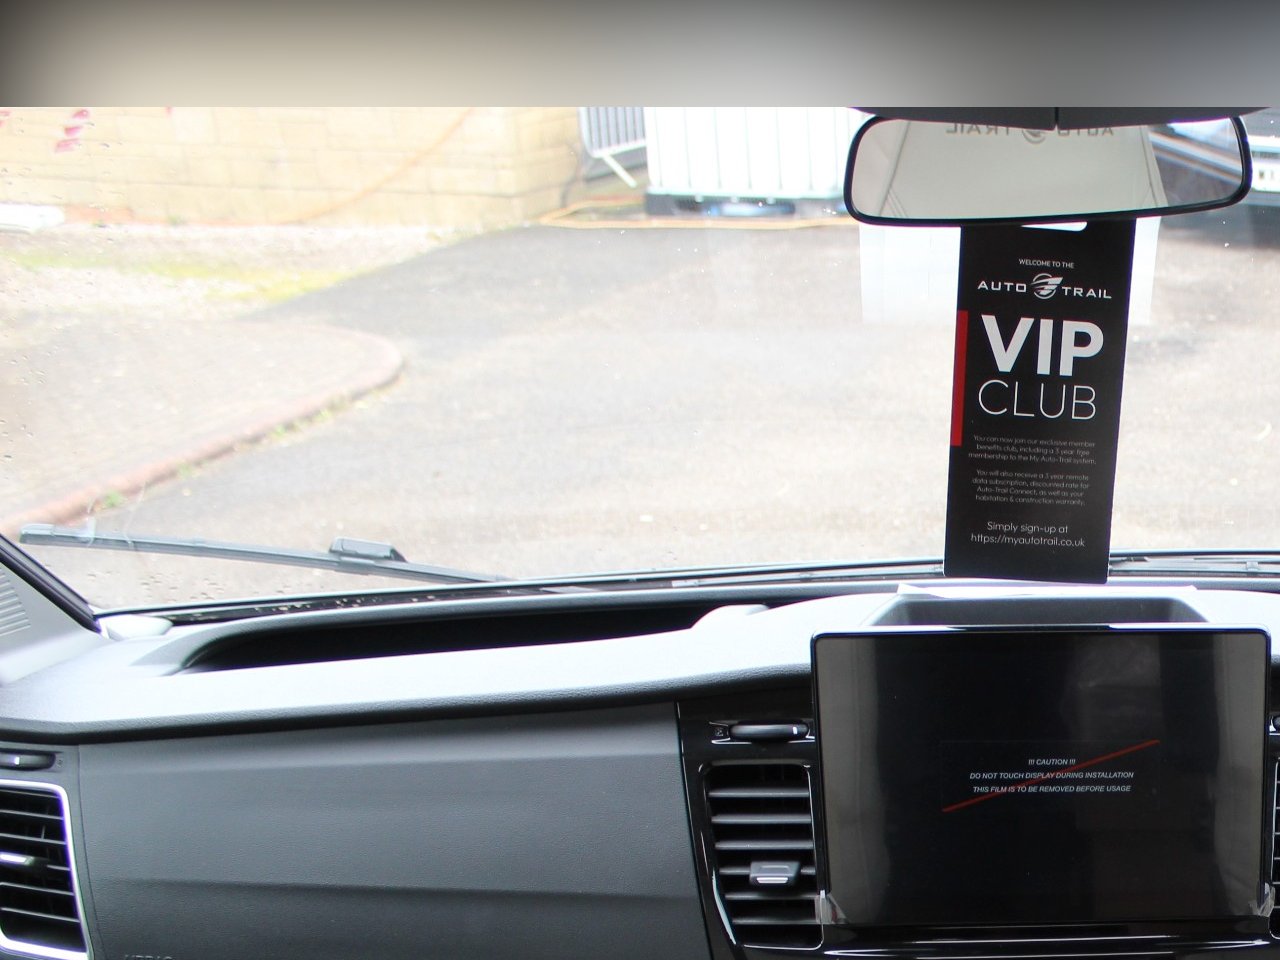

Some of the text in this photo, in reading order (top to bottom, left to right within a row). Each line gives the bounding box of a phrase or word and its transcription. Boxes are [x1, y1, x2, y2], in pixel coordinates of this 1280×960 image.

[1018, 258, 1050, 267] WELCOME
[1062, 261, 1075, 269] THE
[977, 280, 1112, 299] AUTO TRAIL
[981, 314, 1104, 376] VIP
[978, 379, 1096, 420] CLUB
[1039, 438, 1067, 446] exclusive
[1019, 446, 1047, 455] including
[968, 453, 1008, 461] membership
[975, 495, 1008, 503] habitation
[987, 521, 1068, 535] Simply sign-up at
[971, 533, 1085, 547] https://myautotrail.co.uk
[1056, 771, 1083, 779] DURING
